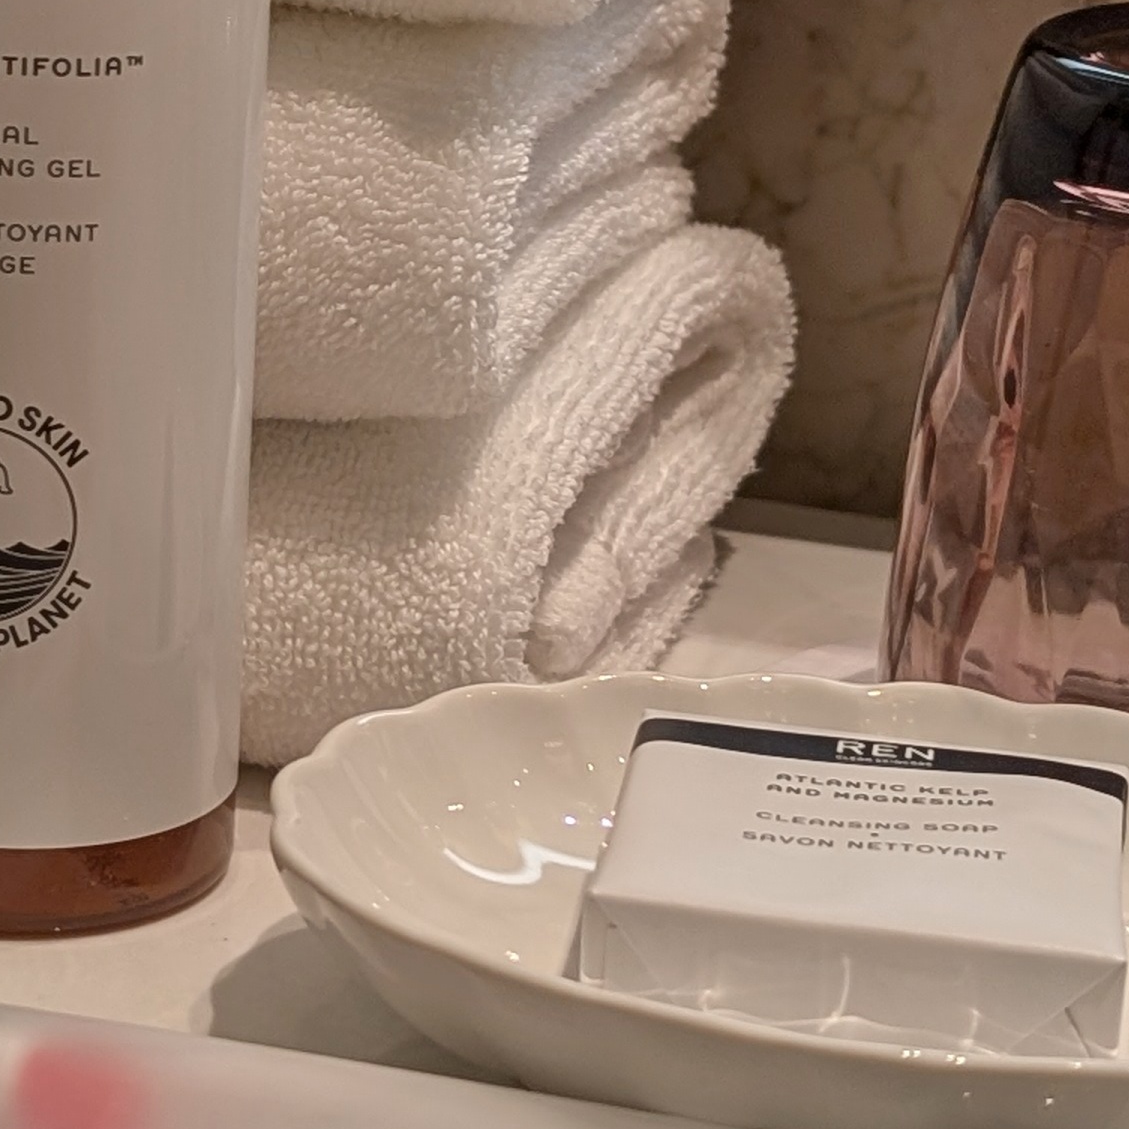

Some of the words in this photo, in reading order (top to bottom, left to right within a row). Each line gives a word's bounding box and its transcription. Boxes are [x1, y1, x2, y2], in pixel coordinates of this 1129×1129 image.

[46, 159, 101, 178] GEL
[18, 406, 89, 468] SKIN
[836, 740, 935, 761] REN
[766, 783, 821, 797] AND
[833, 791, 994, 807] MAGNESIUM
[776, 773, 906, 792] ATLANTIC
[918, 785, 990, 796] KELP
[756, 811, 911, 831] CLEANSING
[923, 823, 999, 833] SOAP
[742, 830, 834, 848] SAVON
[847, 840, 1007, 861] NETTOYANT
